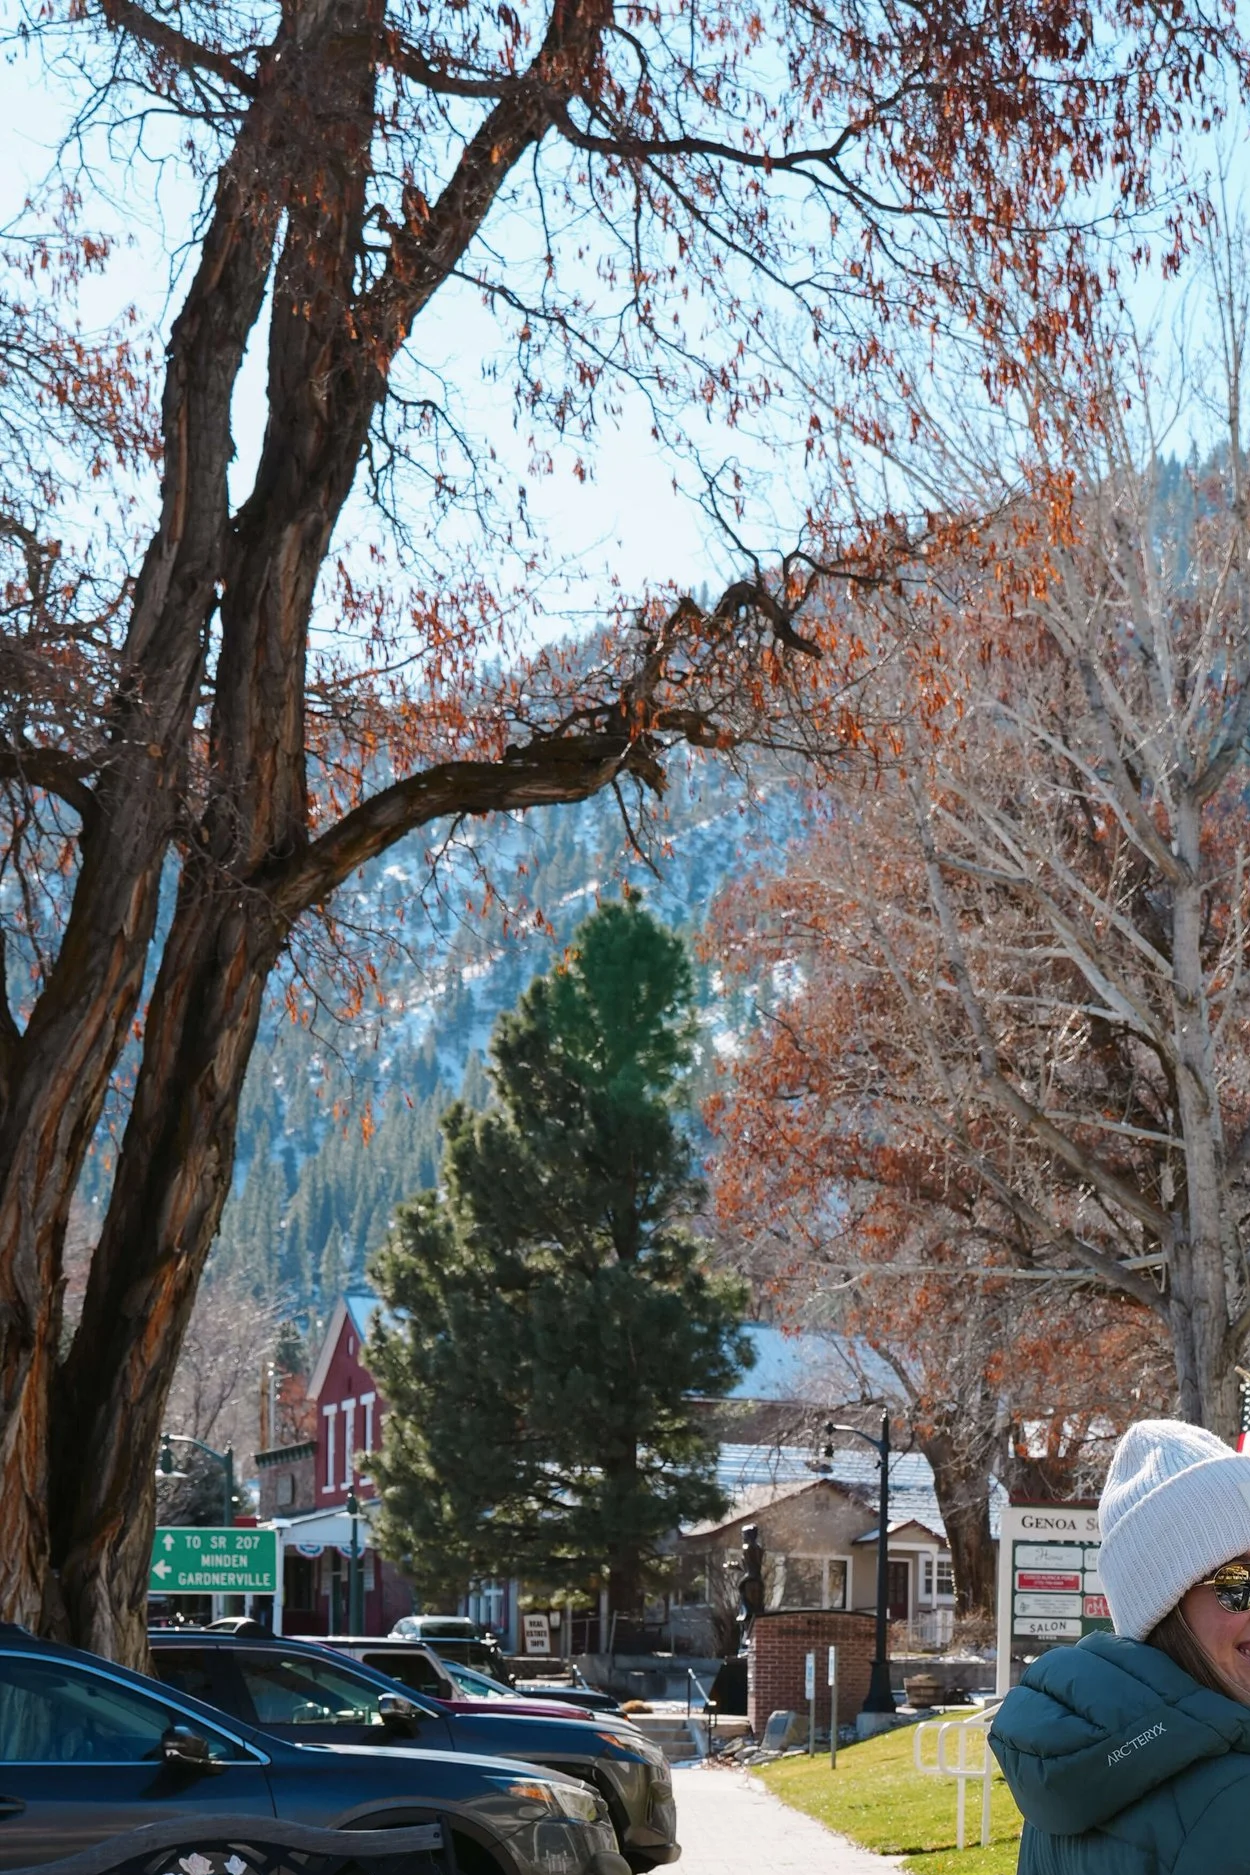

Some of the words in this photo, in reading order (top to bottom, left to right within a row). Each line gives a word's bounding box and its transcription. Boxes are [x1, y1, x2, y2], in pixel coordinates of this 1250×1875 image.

[1021, 1515, 1077, 1530] GENOA
[185, 1536, 202, 1549] TO
[210, 1536, 227, 1549] SR
[236, 1536, 260, 1549] 207
[201, 1554, 248, 1568] MINDEN
[178, 1572, 271, 1587] GARDNERVILLE
[1030, 1622, 1067, 1633] SALON
[1107, 1722, 1167, 1767] ARC'TERYX
